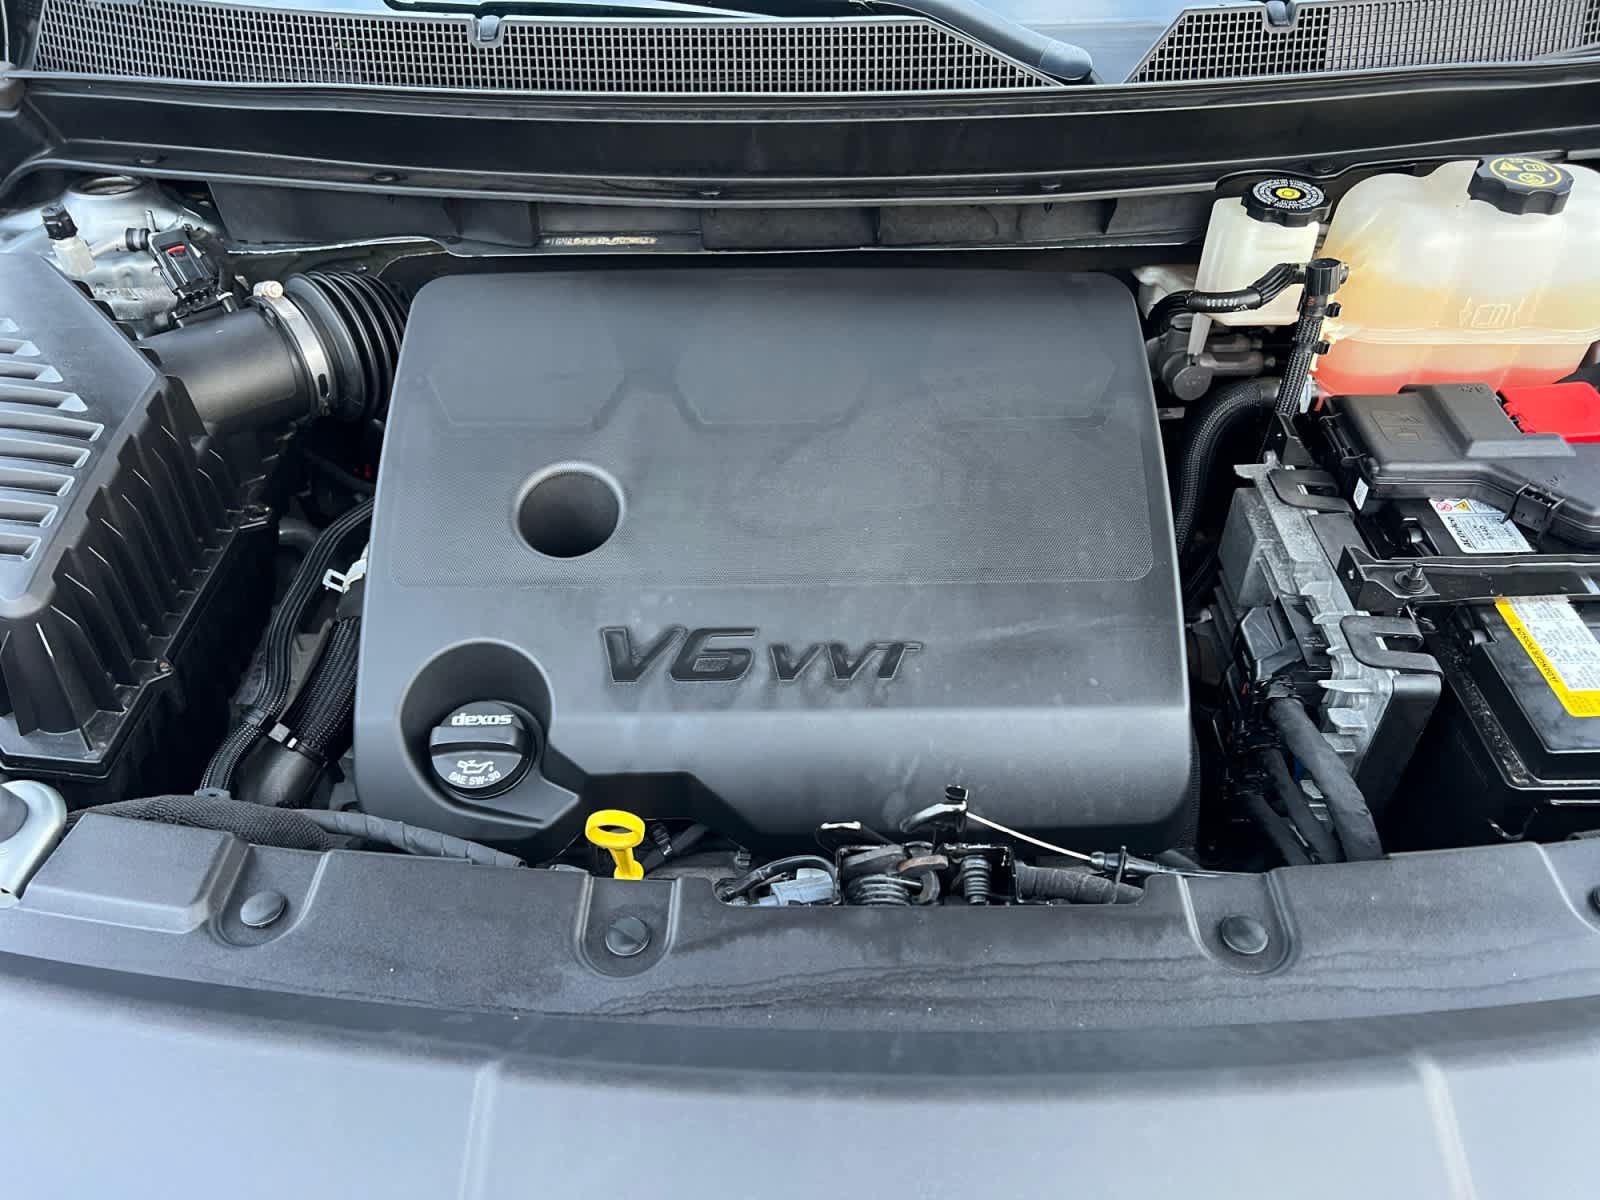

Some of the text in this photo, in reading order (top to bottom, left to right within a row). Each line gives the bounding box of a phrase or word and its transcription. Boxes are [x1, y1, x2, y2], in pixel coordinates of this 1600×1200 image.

[600, 627, 923, 683] V6 VVT
[451, 713, 514, 726] dexos
[448, 771, 501, 785] SAE 5W-30
